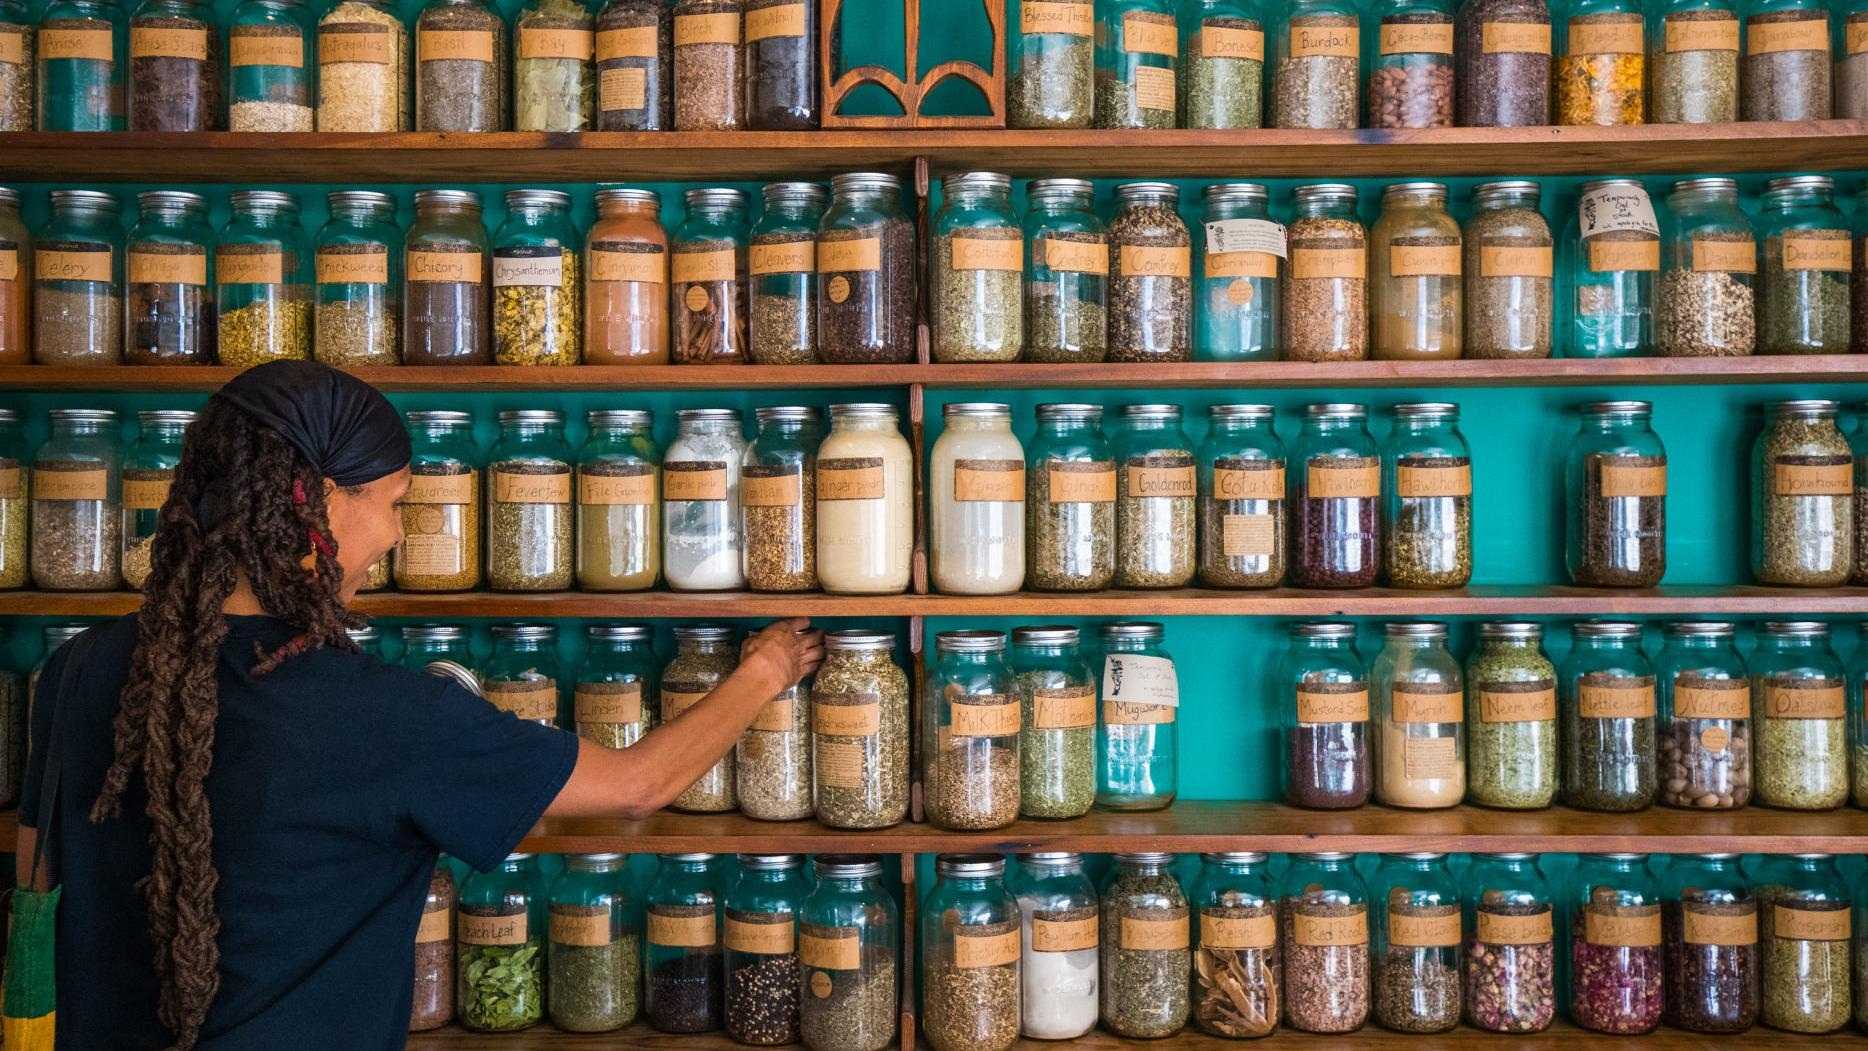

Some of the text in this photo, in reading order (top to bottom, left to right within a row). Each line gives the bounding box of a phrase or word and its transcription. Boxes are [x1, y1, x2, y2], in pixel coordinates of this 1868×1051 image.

[1022, 6, 1063, 24] Blessed
[414, 256, 462, 279] Chicory
[1138, 472, 1192, 493] Goldenrod
[491, 920, 518, 939] Leaf
